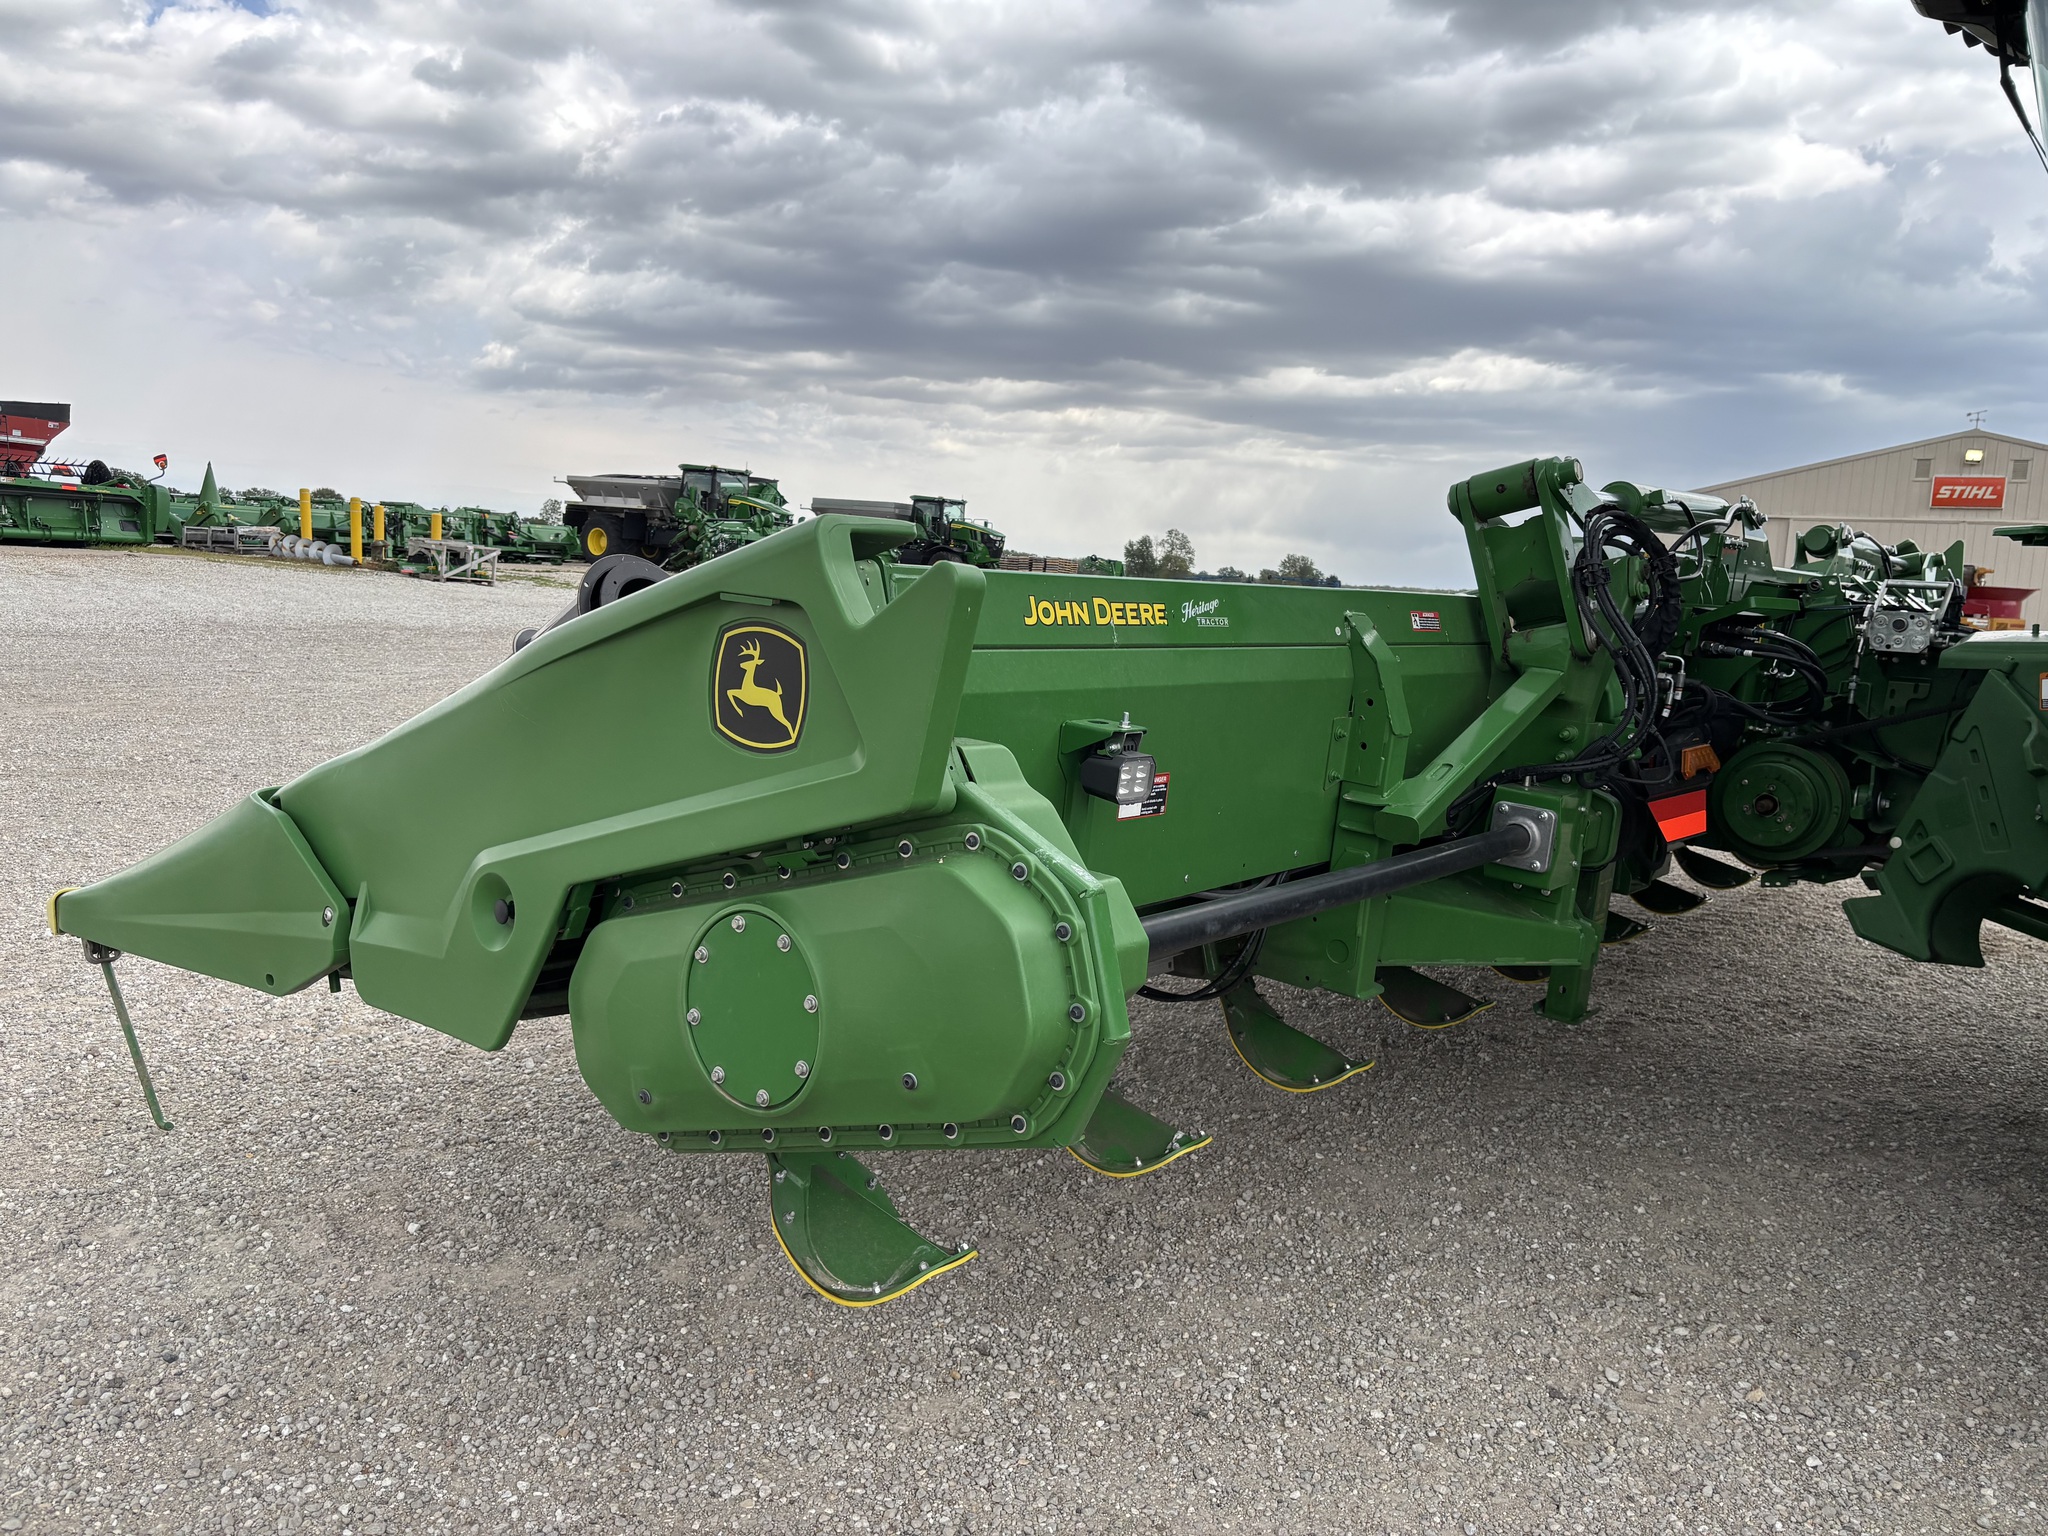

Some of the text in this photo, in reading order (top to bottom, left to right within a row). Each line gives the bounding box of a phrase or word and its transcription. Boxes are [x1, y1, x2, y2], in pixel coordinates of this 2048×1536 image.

[1936, 486, 1997, 499] STIHL
[1024, 595, 1168, 626] JOHN DEERE
[1181, 599, 1219, 623] Heritage
[1197, 618, 1229, 626] TRACTOR
